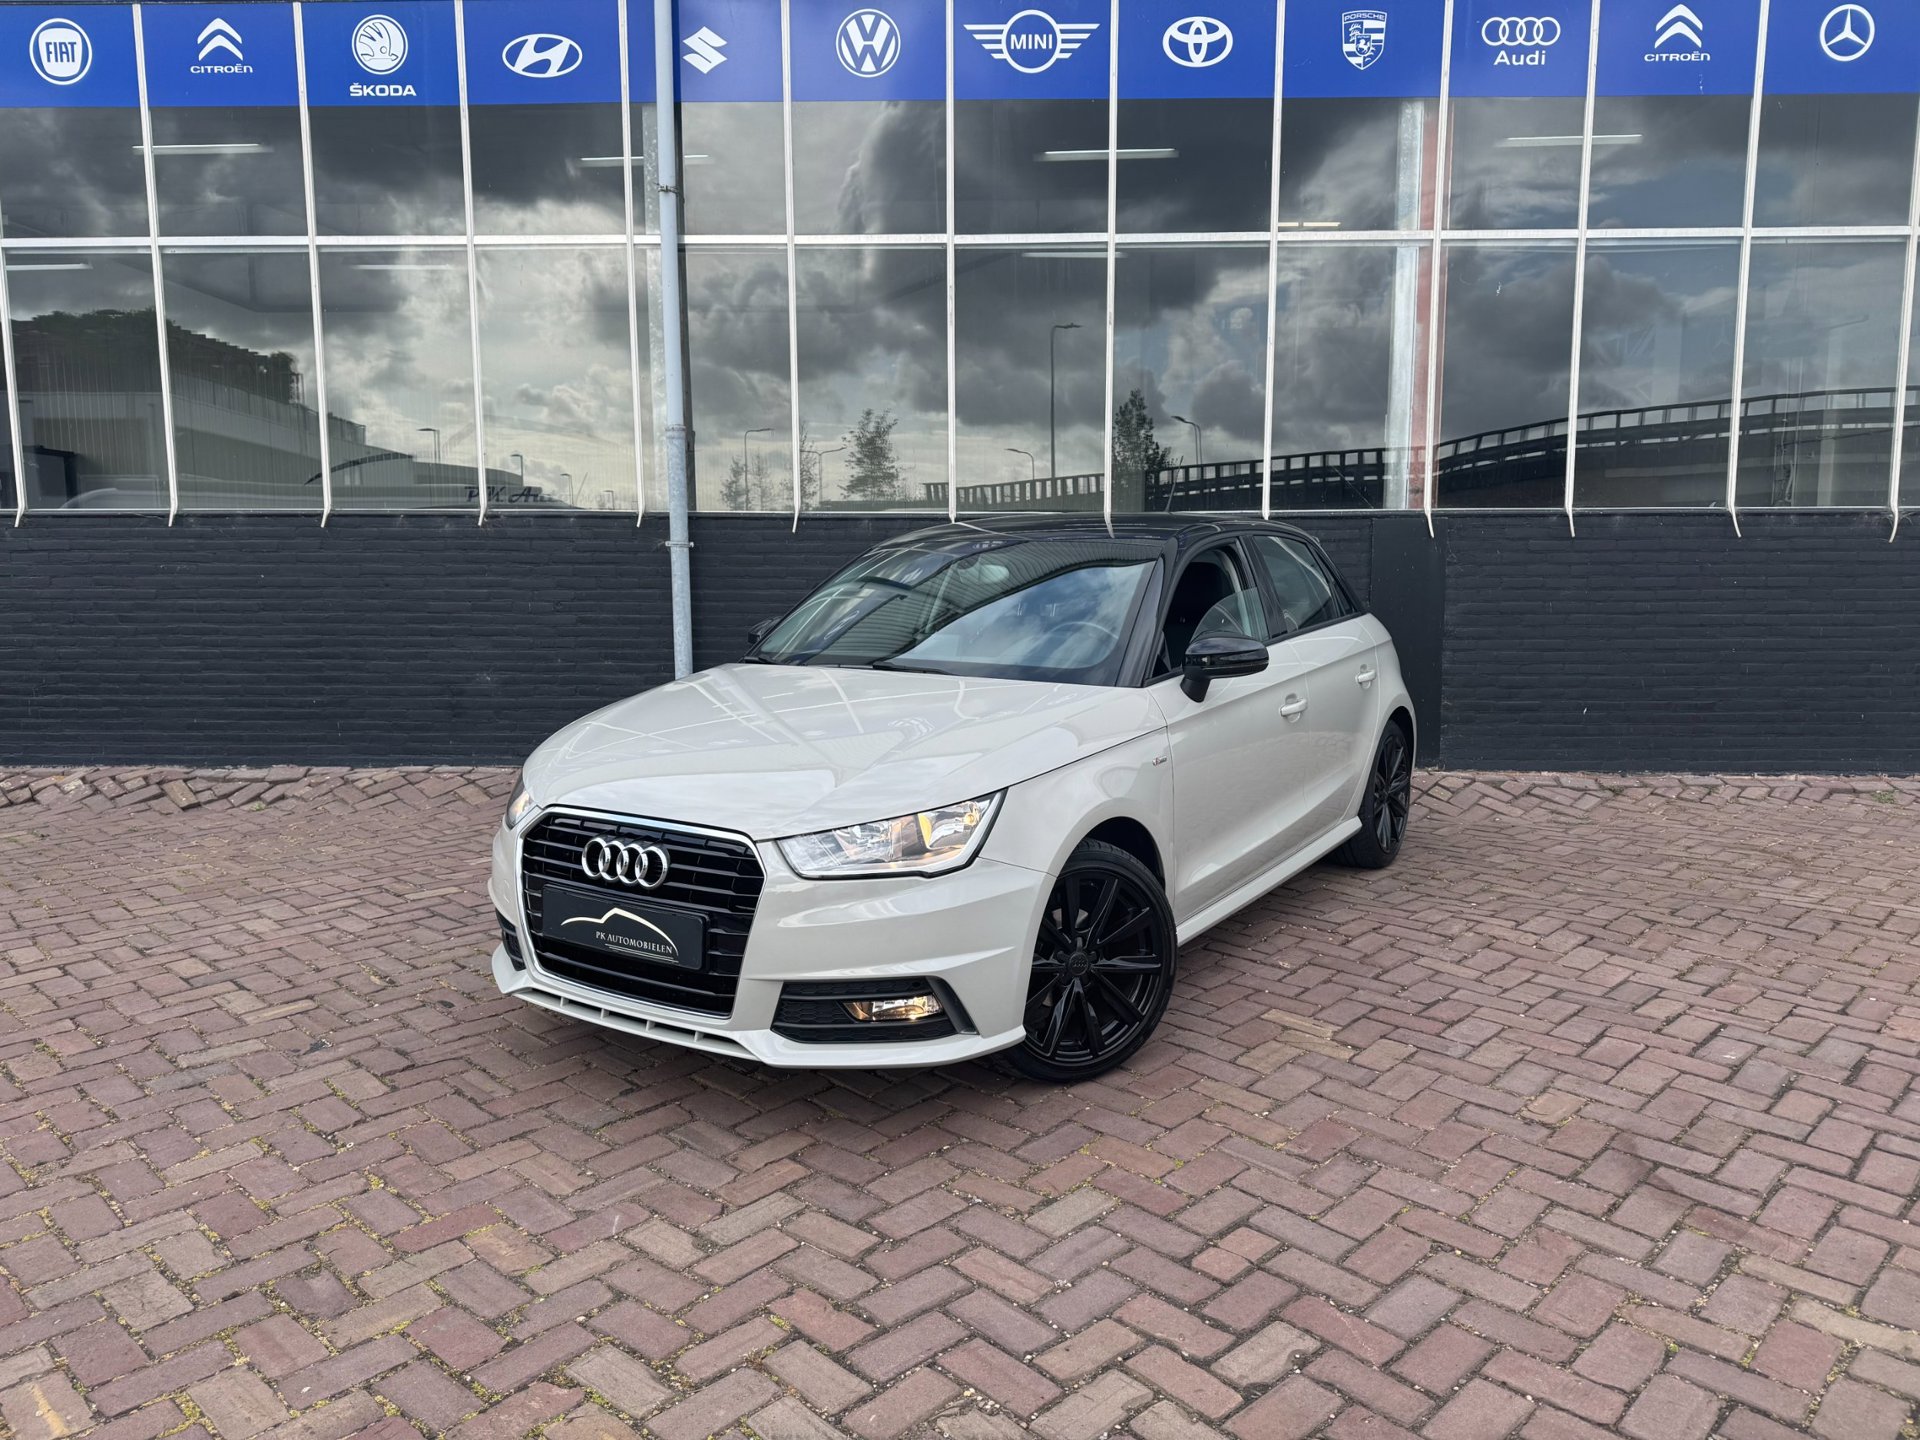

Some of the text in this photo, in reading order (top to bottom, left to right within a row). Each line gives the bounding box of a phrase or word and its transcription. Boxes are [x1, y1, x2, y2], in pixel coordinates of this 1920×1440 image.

[1344, 12, 1385, 21] PORSCHE
[1010, 33, 1053, 50] MINI
[45, 41, 77, 63] FIAT
[1493, 50, 1547, 66] Audi
[349, 82, 417, 97] ŠKODA
[595, 930, 673, 954] PK AUTOMOBIELEN
